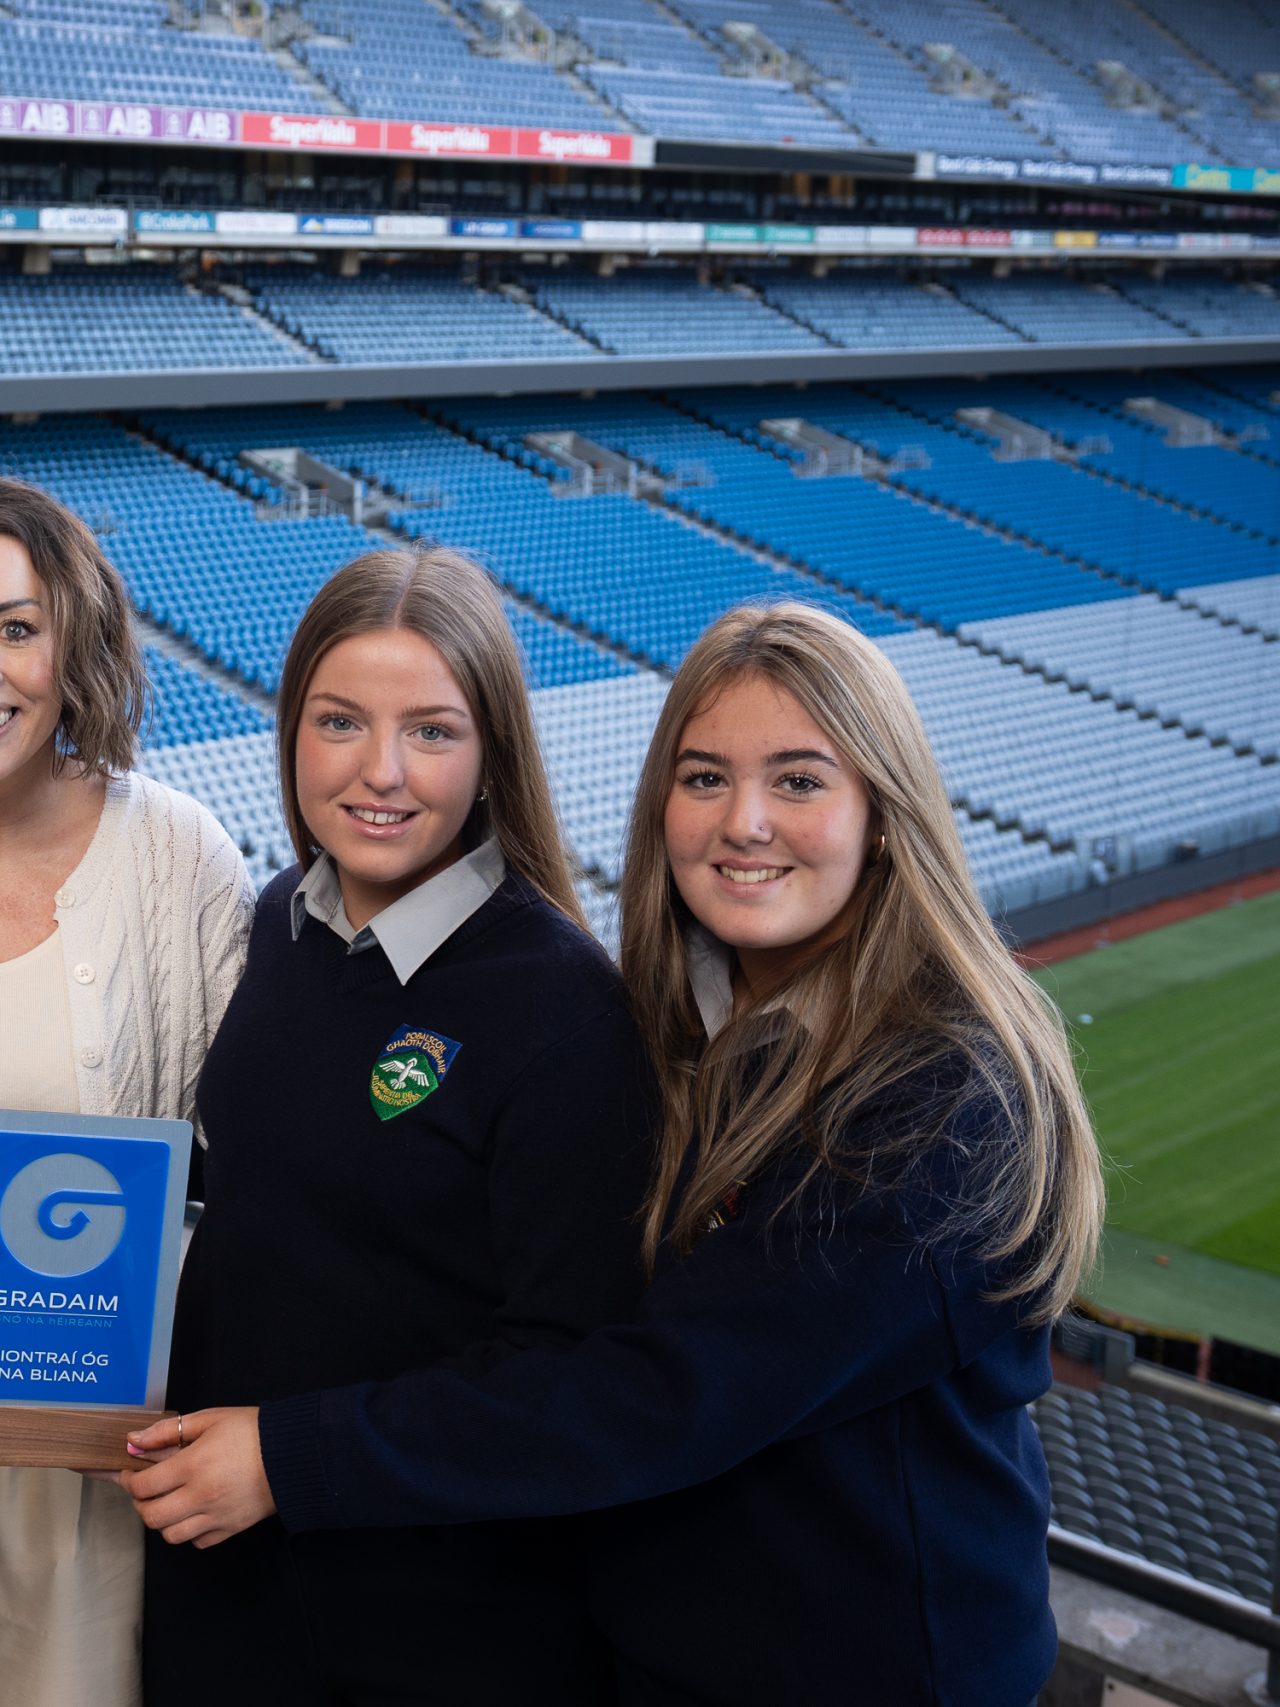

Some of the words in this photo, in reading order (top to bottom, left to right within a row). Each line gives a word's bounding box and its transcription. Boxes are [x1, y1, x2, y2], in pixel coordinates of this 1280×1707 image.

[22, 102, 70, 132] AIB
[107, 107, 153, 136] AIB
[187, 111, 232, 139] AIB
[405, 1032, 447, 1054] POBALSCOIL
[386, 1039, 422, 1052] GHAOTH
[422, 1043, 447, 1074] DOBHAIR
[26, 1316, 44, 1325] NA
[48, 1316, 113, 1328] hÉIREANN
[81, 1350, 109, 1366] ÓG
[30, 1368, 98, 1384] BLIANA
